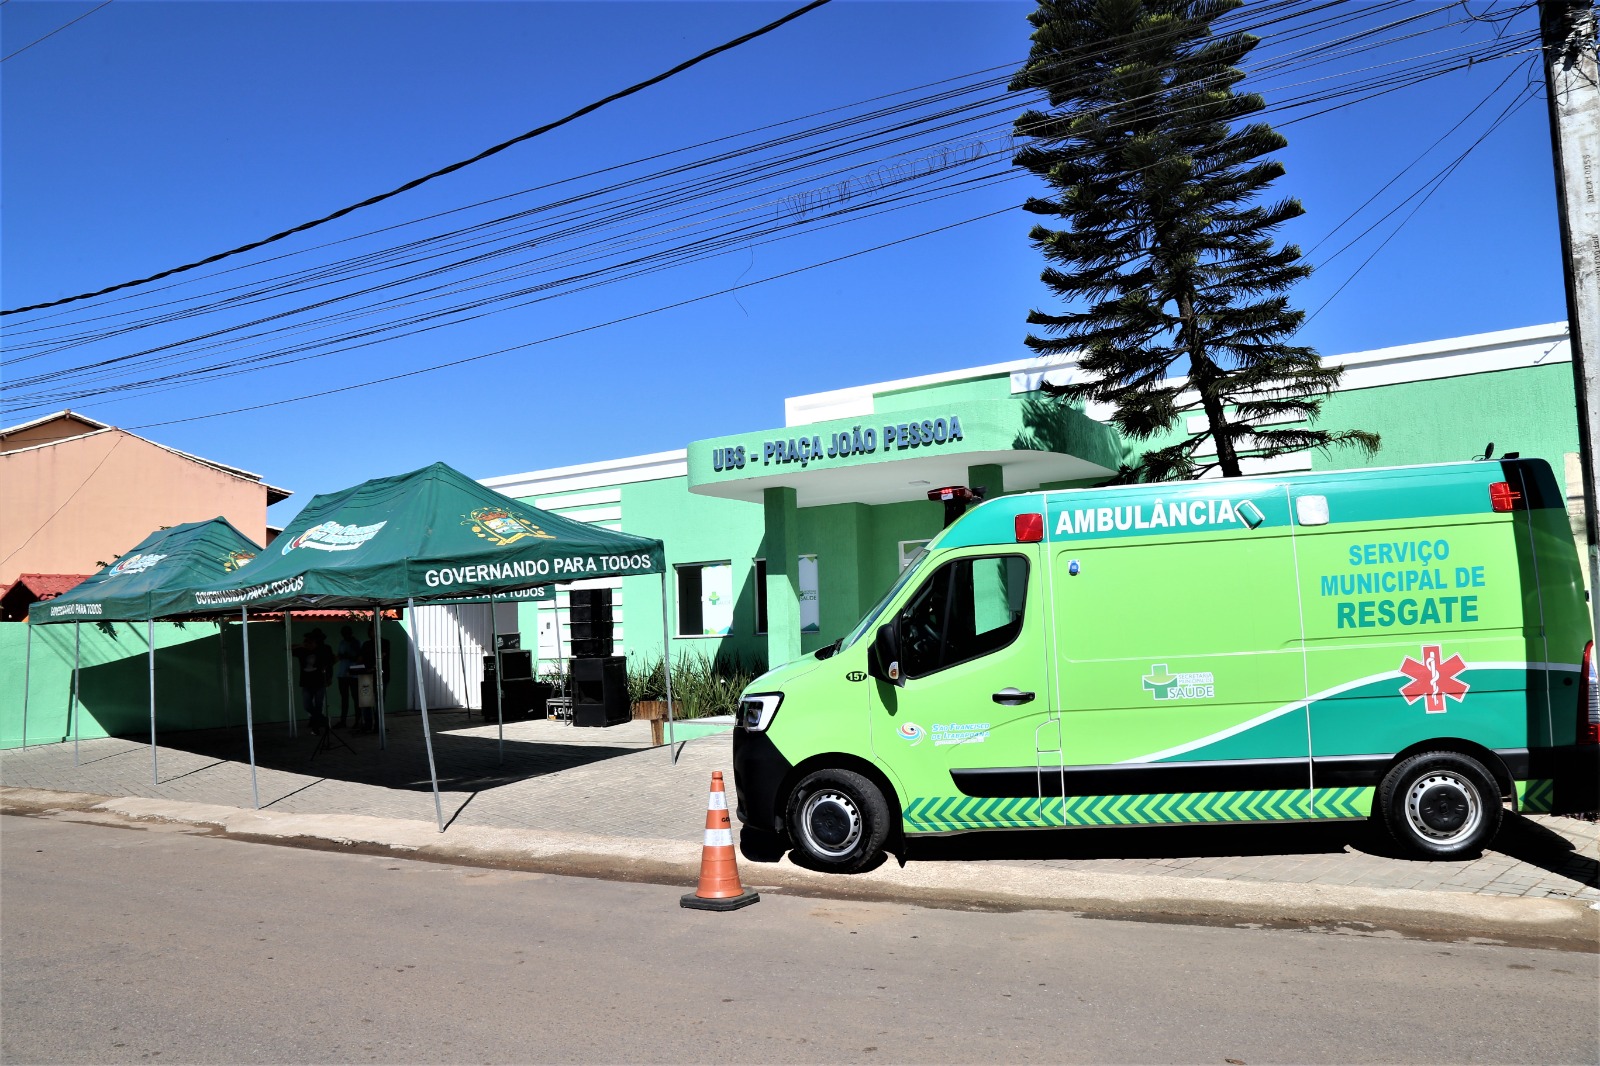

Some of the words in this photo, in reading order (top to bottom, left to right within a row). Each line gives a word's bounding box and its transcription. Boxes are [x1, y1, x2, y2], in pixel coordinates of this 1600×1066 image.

[713, 446, 746, 472] UBS
[763, 435, 824, 468] PRAÇA
[827, 425, 877, 459] JOÃO
[883, 415, 963, 452] PESSOA
[1055, 498, 1236, 535] AMBULÂNCIA
[1349, 539, 1450, 567] SERVIÇO
[425, 559, 550, 587] GOVERNANDO
[554, 556, 597, 574] PARA
[600, 554, 652, 570] TODOS
[1321, 568, 1448, 597] MUNICIPAL
[1455, 565, 1486, 589] DE
[194, 588, 247, 605] GOVERNANDO
[246, 581, 272, 601] PARA
[271, 575, 304, 596] TODOS
[1337, 595, 1479, 629] RESGATE
[848, 672, 865, 681] 157
[1169, 684, 1213, 698] SAÚDE
